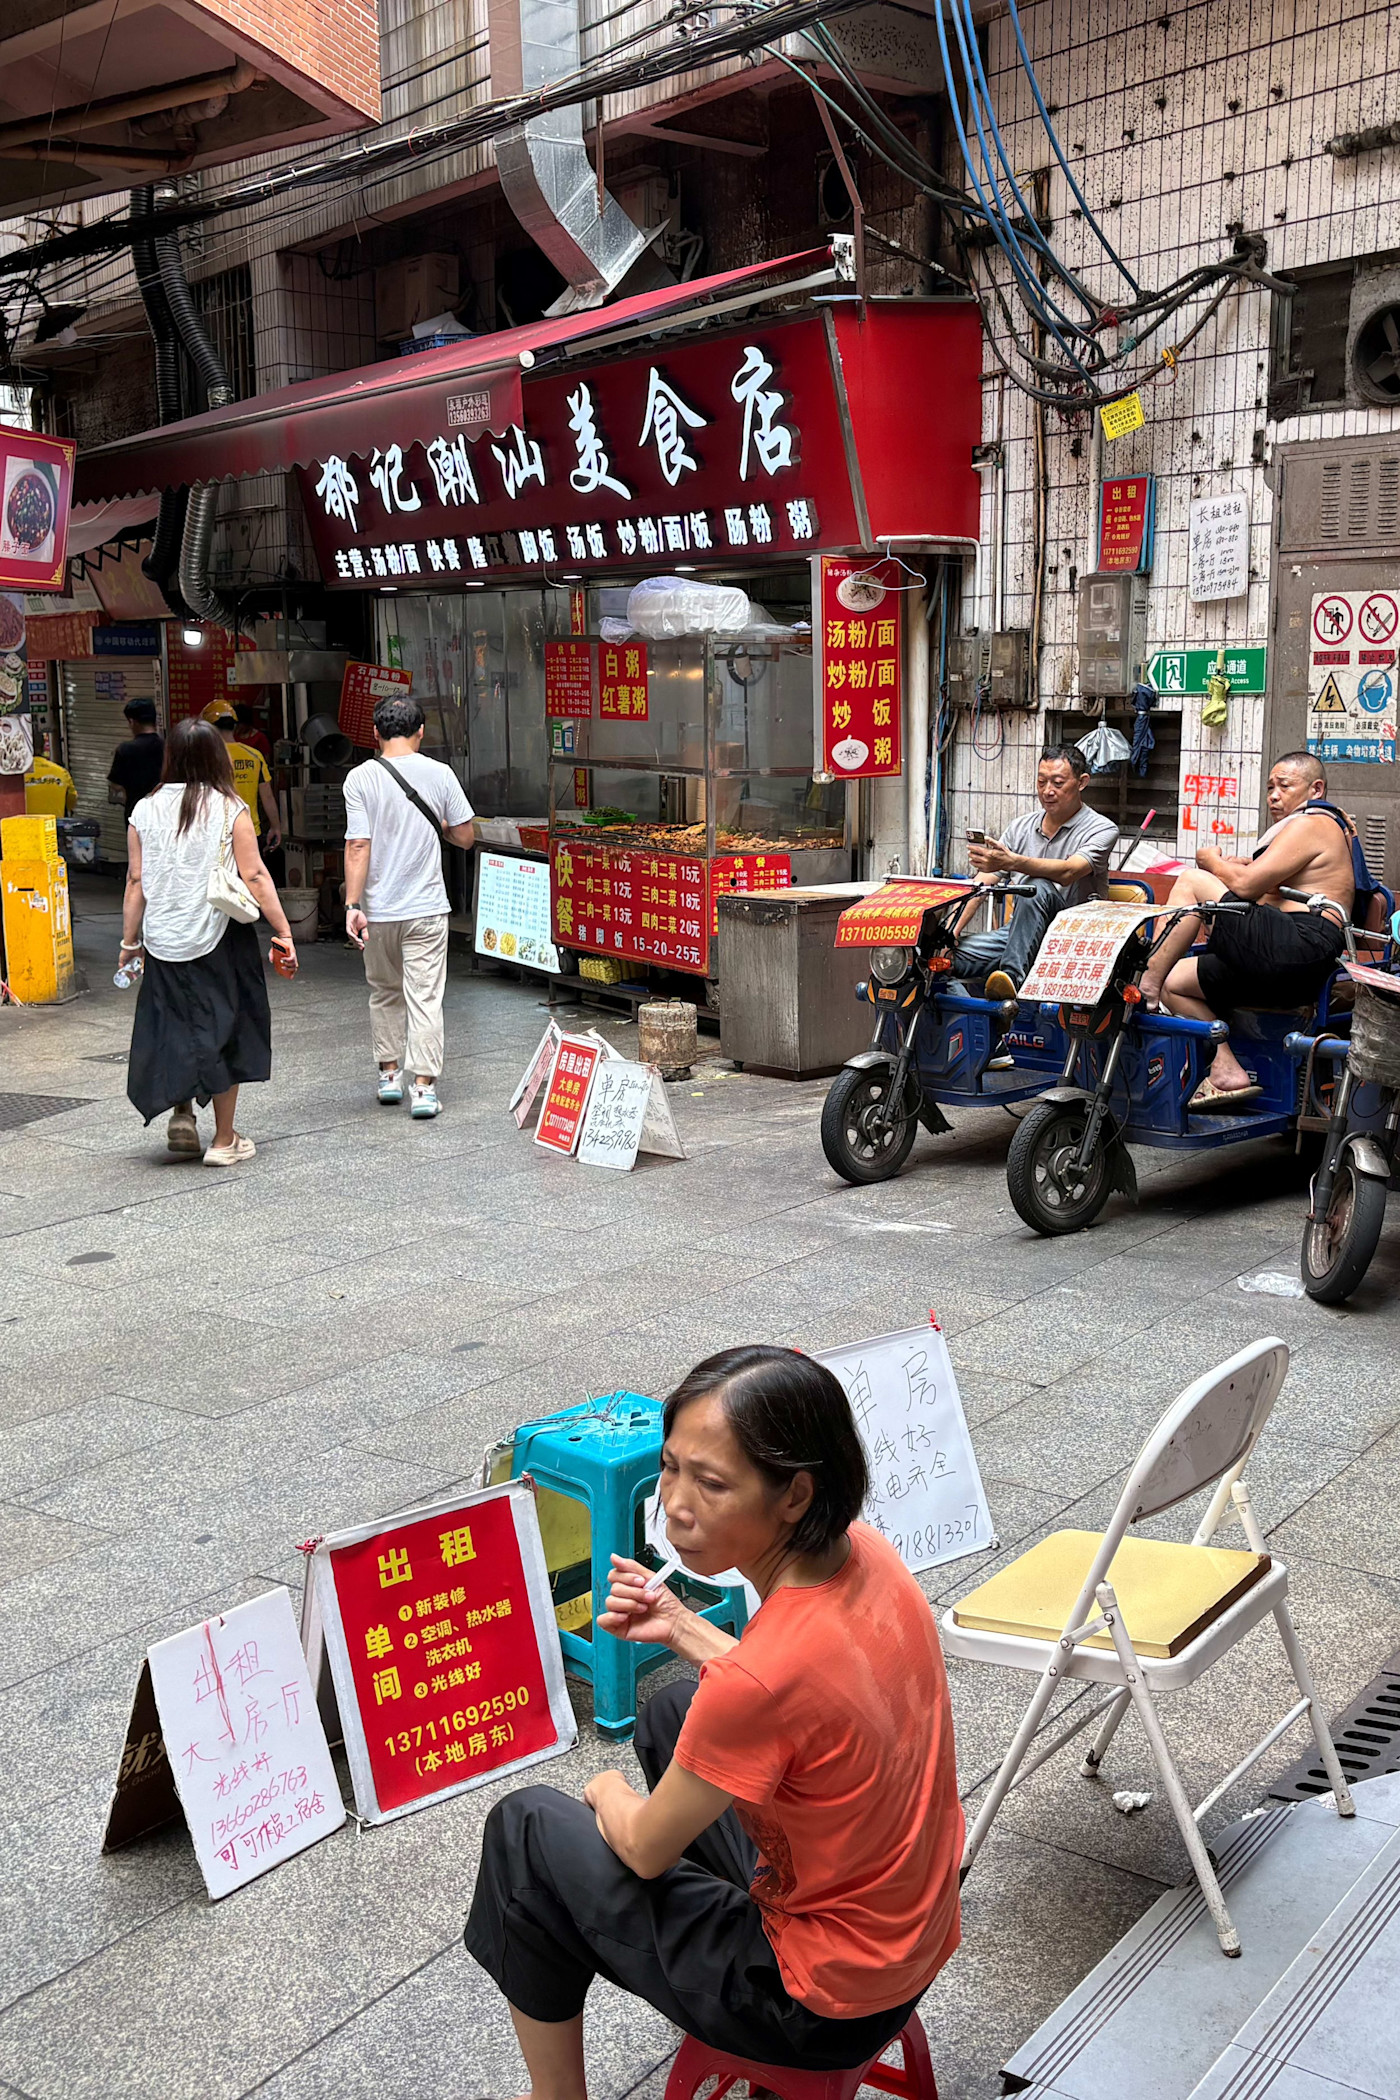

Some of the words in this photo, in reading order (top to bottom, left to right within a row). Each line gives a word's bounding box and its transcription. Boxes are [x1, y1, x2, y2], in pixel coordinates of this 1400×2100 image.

[1112, 485, 1136, 500] 出租
[426, 538, 461, 571] 快餐
[566, 524, 607, 559] 汤饭
[724, 503, 772, 545] 肠粉
[786, 500, 813, 539] 粥
[827, 619, 896, 649] 汤粉/面
[606, 649, 639, 678] 白粥
[827, 658, 896, 689] 炒粉/面
[1207, 659, 1247, 675] 应通道
[603, 685, 646, 715] 红薯粥
[832, 698, 891, 729] 炒饭
[874, 737, 892, 765] 粥
[641, 860, 677, 881] 二肉二菜
[681, 866, 700, 884] 15元
[577, 876, 611, 896] 一肉二菜
[614, 882, 632, 899] 12元
[642, 886, 677, 907] 三肉二菜
[681, 893, 700, 911] 18元
[578, 901, 611, 922] 二肉一菜
[614, 907, 632, 925] 13元
[641, 912, 677, 934] 四肉二菜
[680, 919, 700, 938] 20元
[841, 925, 917, 941] 13710305598
[633, 936, 700, 964] 15-20-25元
[1045, 938, 1073, 955] 空调
[1074, 939, 1116, 958] 电视机
[1035, 961, 1062, 978] 电脑
[1061, 962, 1106, 981] 显示屏
[1041, 983, 1099, 999] 18819280137
[558, 1077, 581, 1096] 大单房
[598, 1074, 630, 1104] 单房
[843, 1346, 937, 1434] 单房
[874, 1424, 936, 1465] 线好
[377, 1525, 477, 1589] 出租
[415, 1586, 467, 1618] 新装修
[420, 1598, 513, 1645] 空调、热水器
[364, 1624, 402, 1706] 单间
[425, 1637, 473, 1668] 洗衣机
[193, 1640, 274, 1704] 出租
[431, 1661, 483, 1694] 光线好
[384, 1686, 530, 1758] 13711692590
[414, 1721, 515, 1777] (本地房东)
[212, 1751, 273, 1801] 光线好
[211, 1765, 308, 1846] 13660286763
